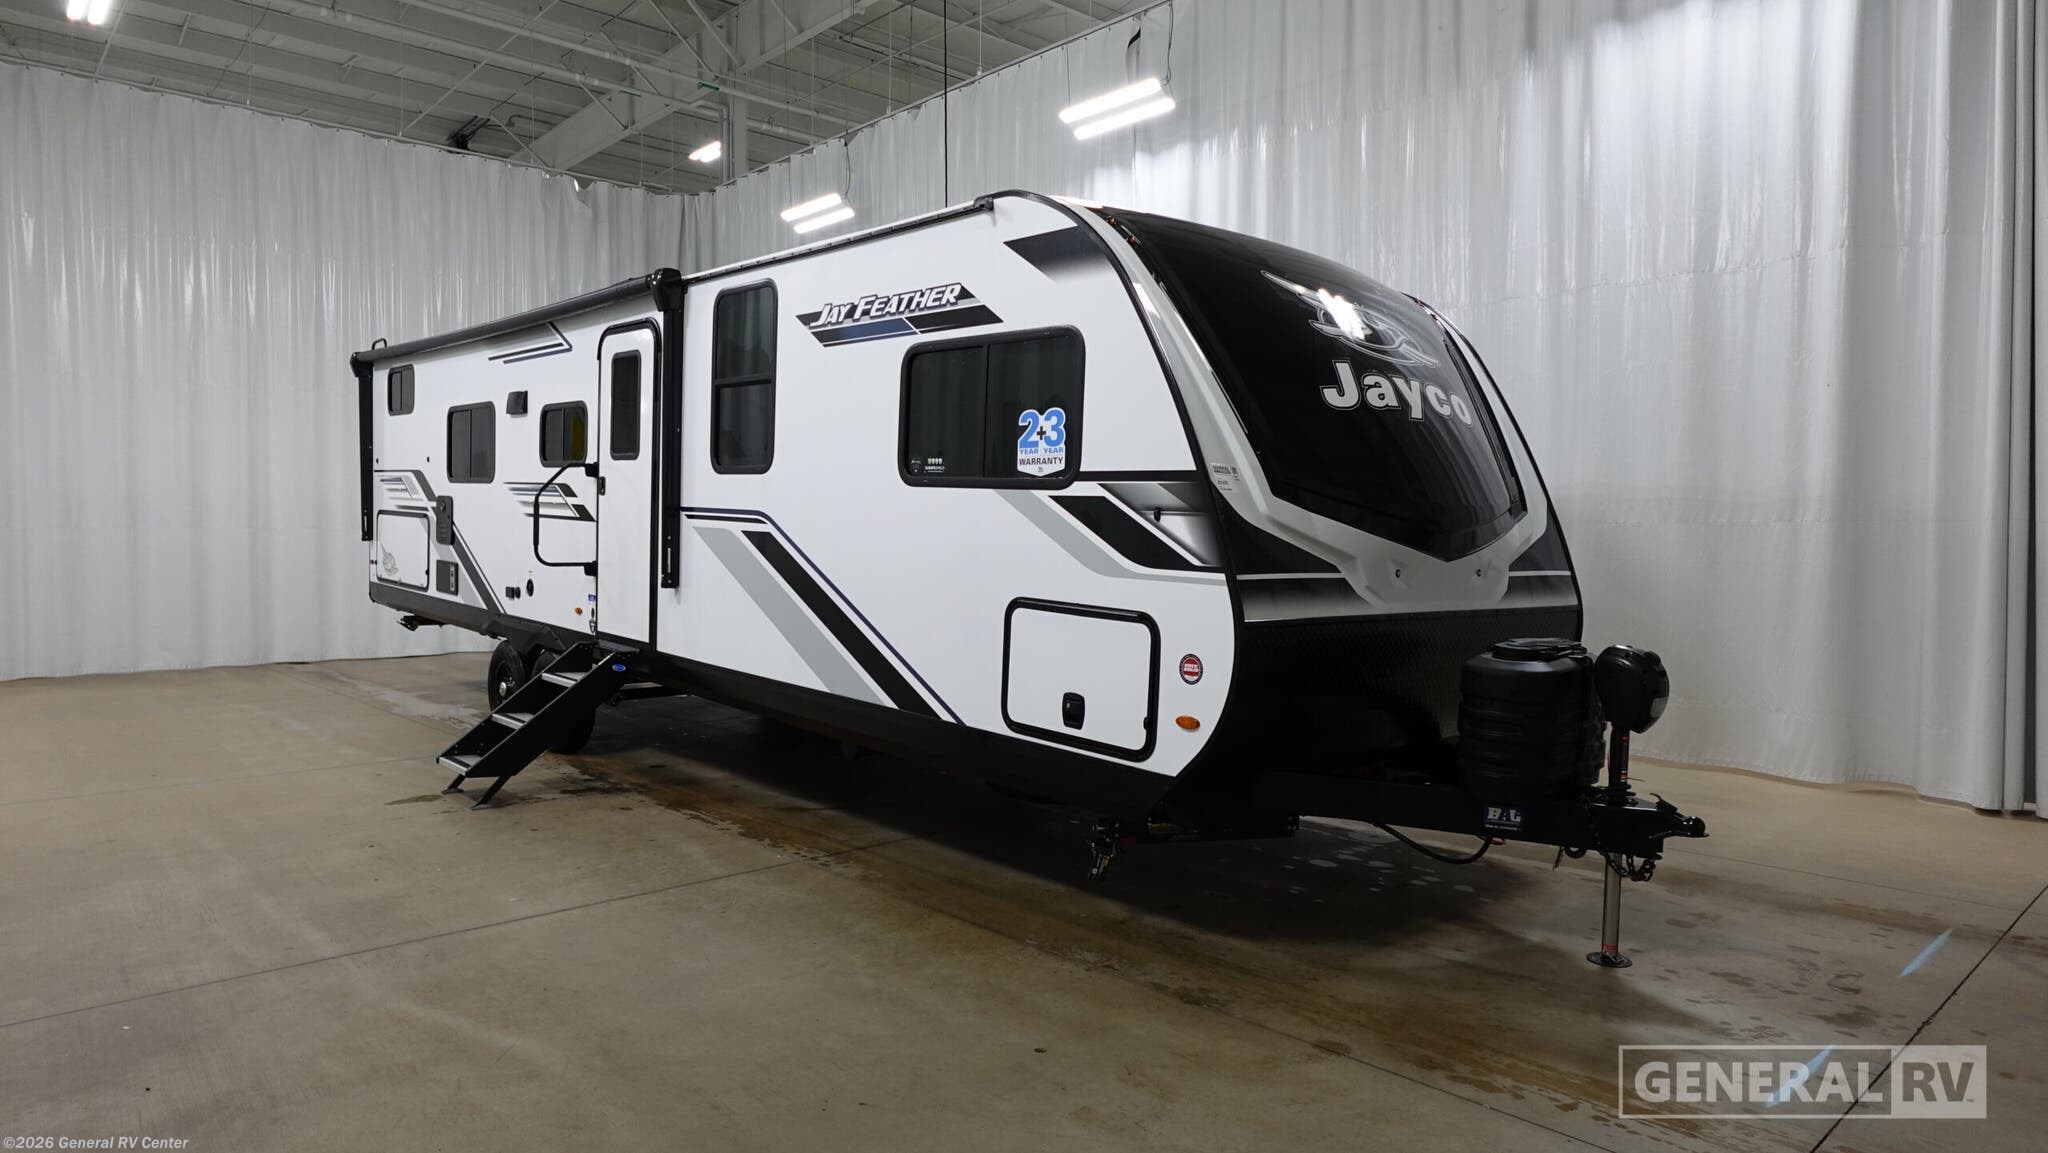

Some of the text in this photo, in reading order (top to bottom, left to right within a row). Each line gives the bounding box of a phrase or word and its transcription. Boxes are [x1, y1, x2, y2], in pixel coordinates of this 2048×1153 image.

[809, 283, 962, 329] JAY FEATHER
[1321, 361, 1473, 426] Jayco
[1019, 457, 1064, 466] WARRANTY
